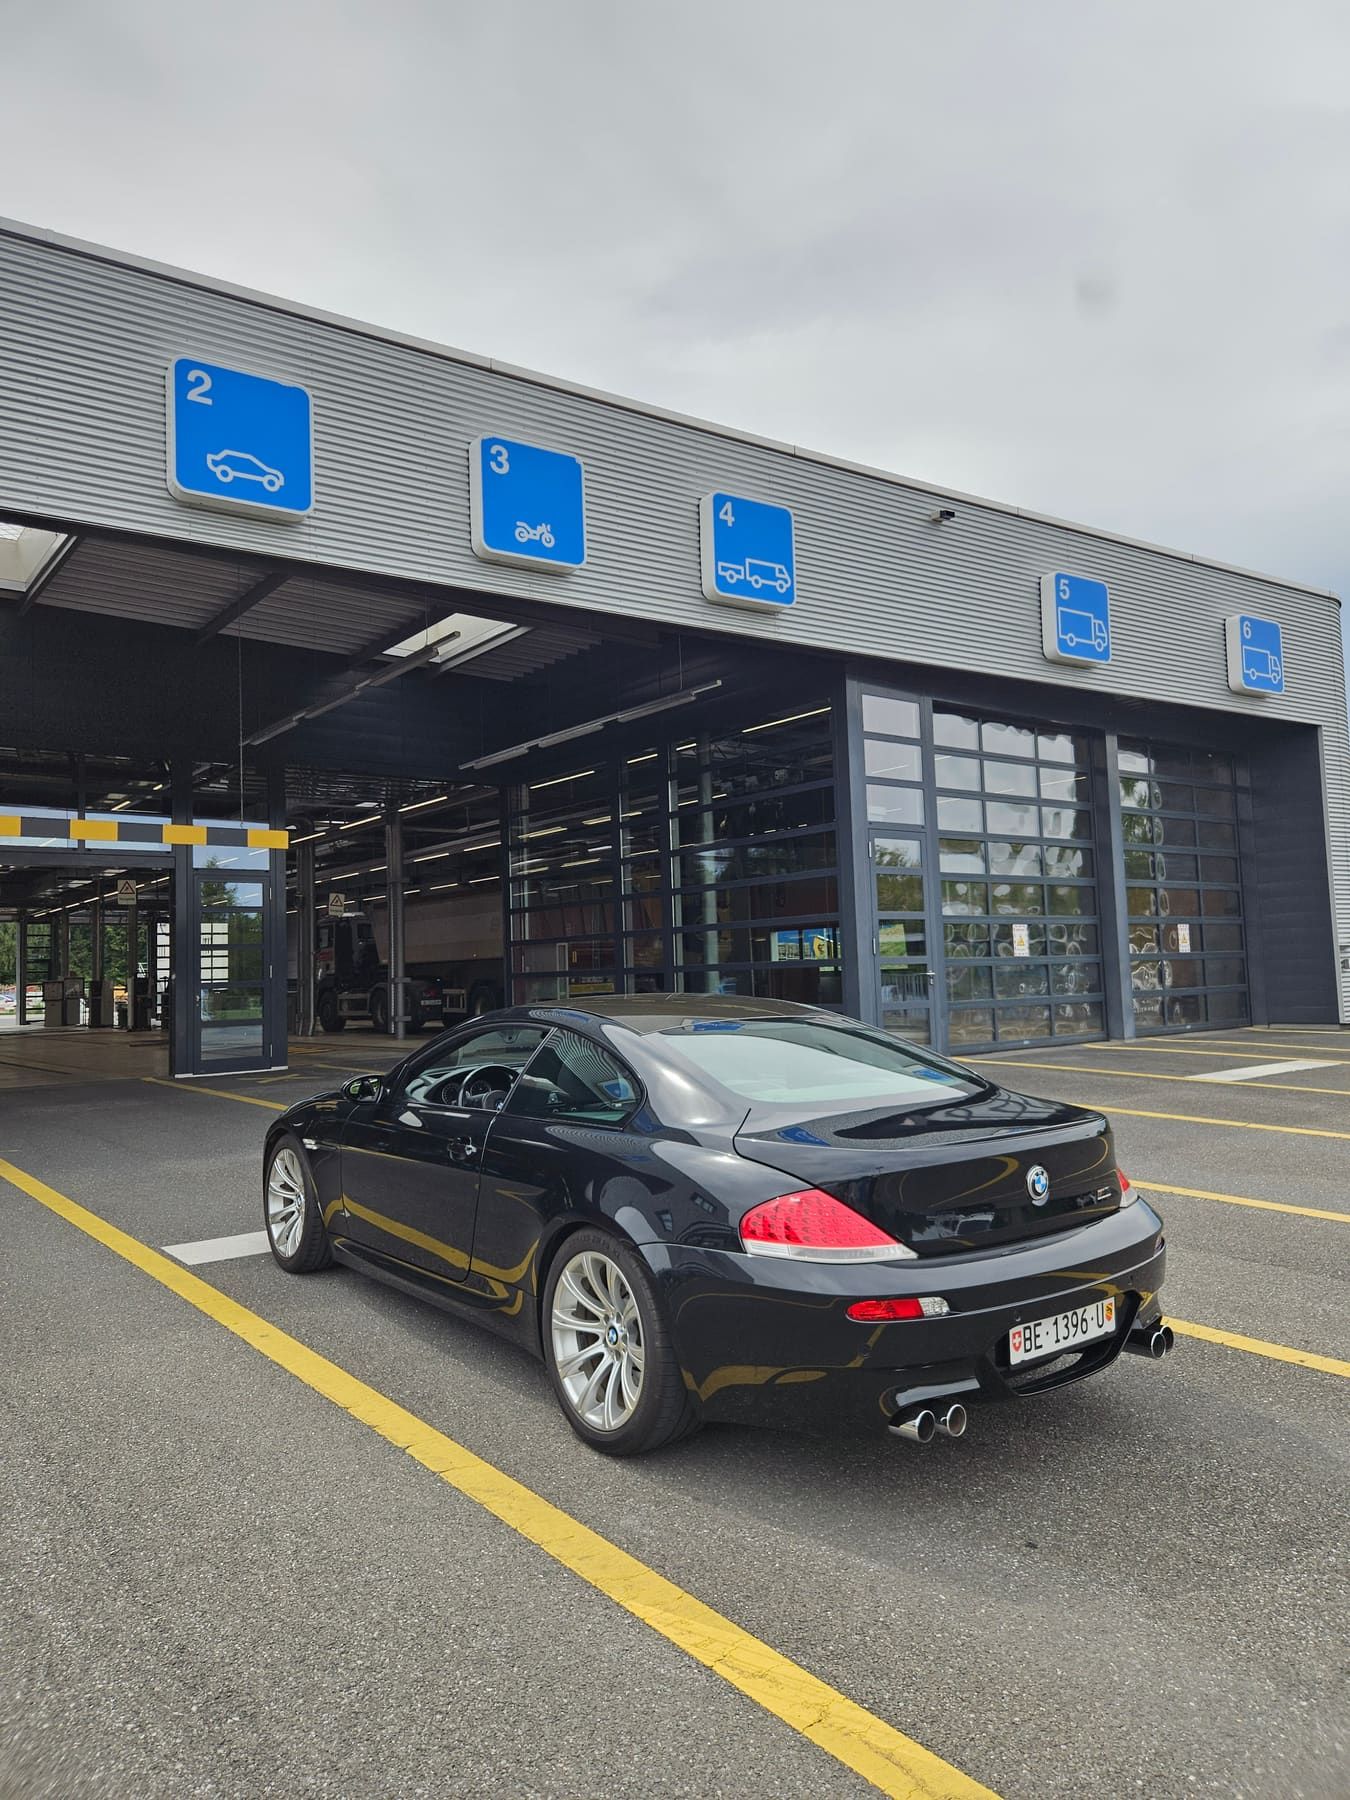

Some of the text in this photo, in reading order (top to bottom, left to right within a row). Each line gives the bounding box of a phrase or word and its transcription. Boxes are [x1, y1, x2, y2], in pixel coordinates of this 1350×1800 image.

[187, 369, 213, 406] 2
[490, 444, 510, 475] 3
[719, 501, 735, 528] 4
[1060, 579, 1070, 600] 5
[1243, 621, 1252, 640] 6
